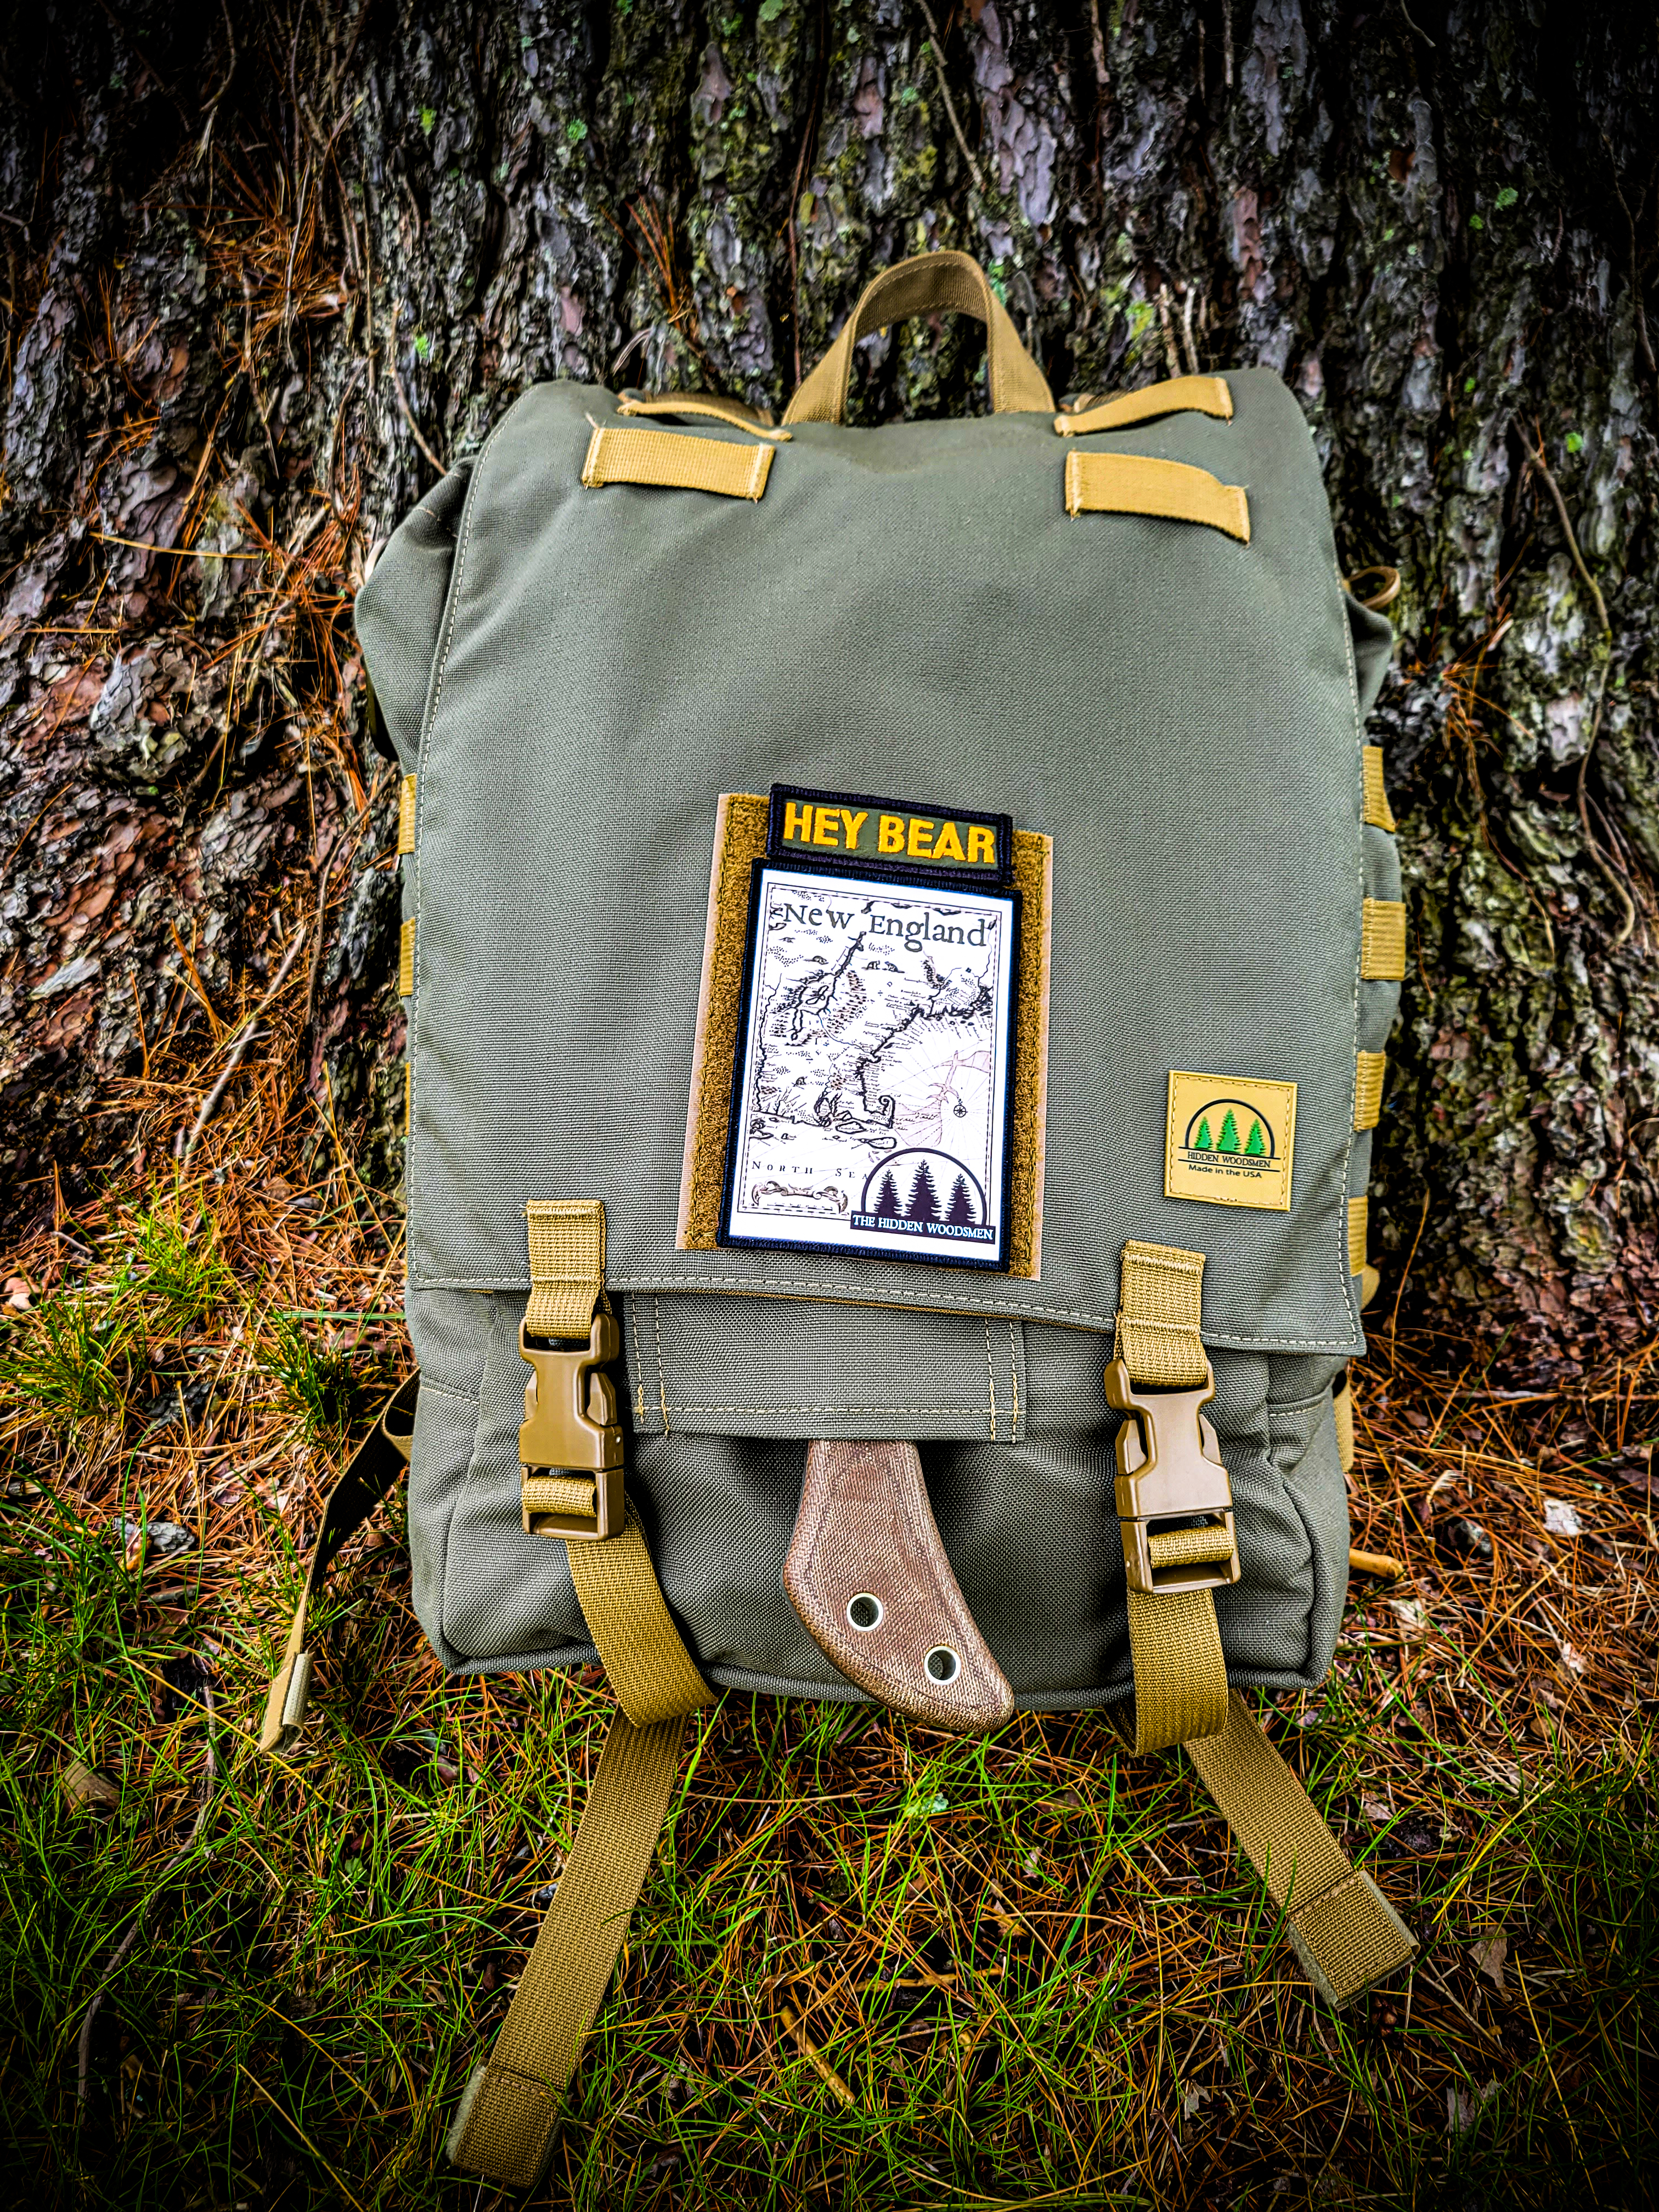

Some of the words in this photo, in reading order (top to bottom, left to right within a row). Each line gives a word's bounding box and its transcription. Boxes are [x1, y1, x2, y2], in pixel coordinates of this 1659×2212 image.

[783, 802, 868, 850] HEY
[878, 814, 995, 864] BEAR
[783, 903, 855, 930] New
[870, 912, 987, 952] England
[752, 1161, 813, 1174] NORTH
[1188, 1152, 1219, 1162] HIDDEN
[1222, 1156, 1271, 1167] WOODSMEN
[1188, 1164, 1213, 1172] Made
[1226, 1168, 1241, 1176] the
[853, 1214, 876, 1227] THE
[878, 1217, 924, 1233] HIDDEN
[926, 1222, 994, 1240] WOODSMEN
